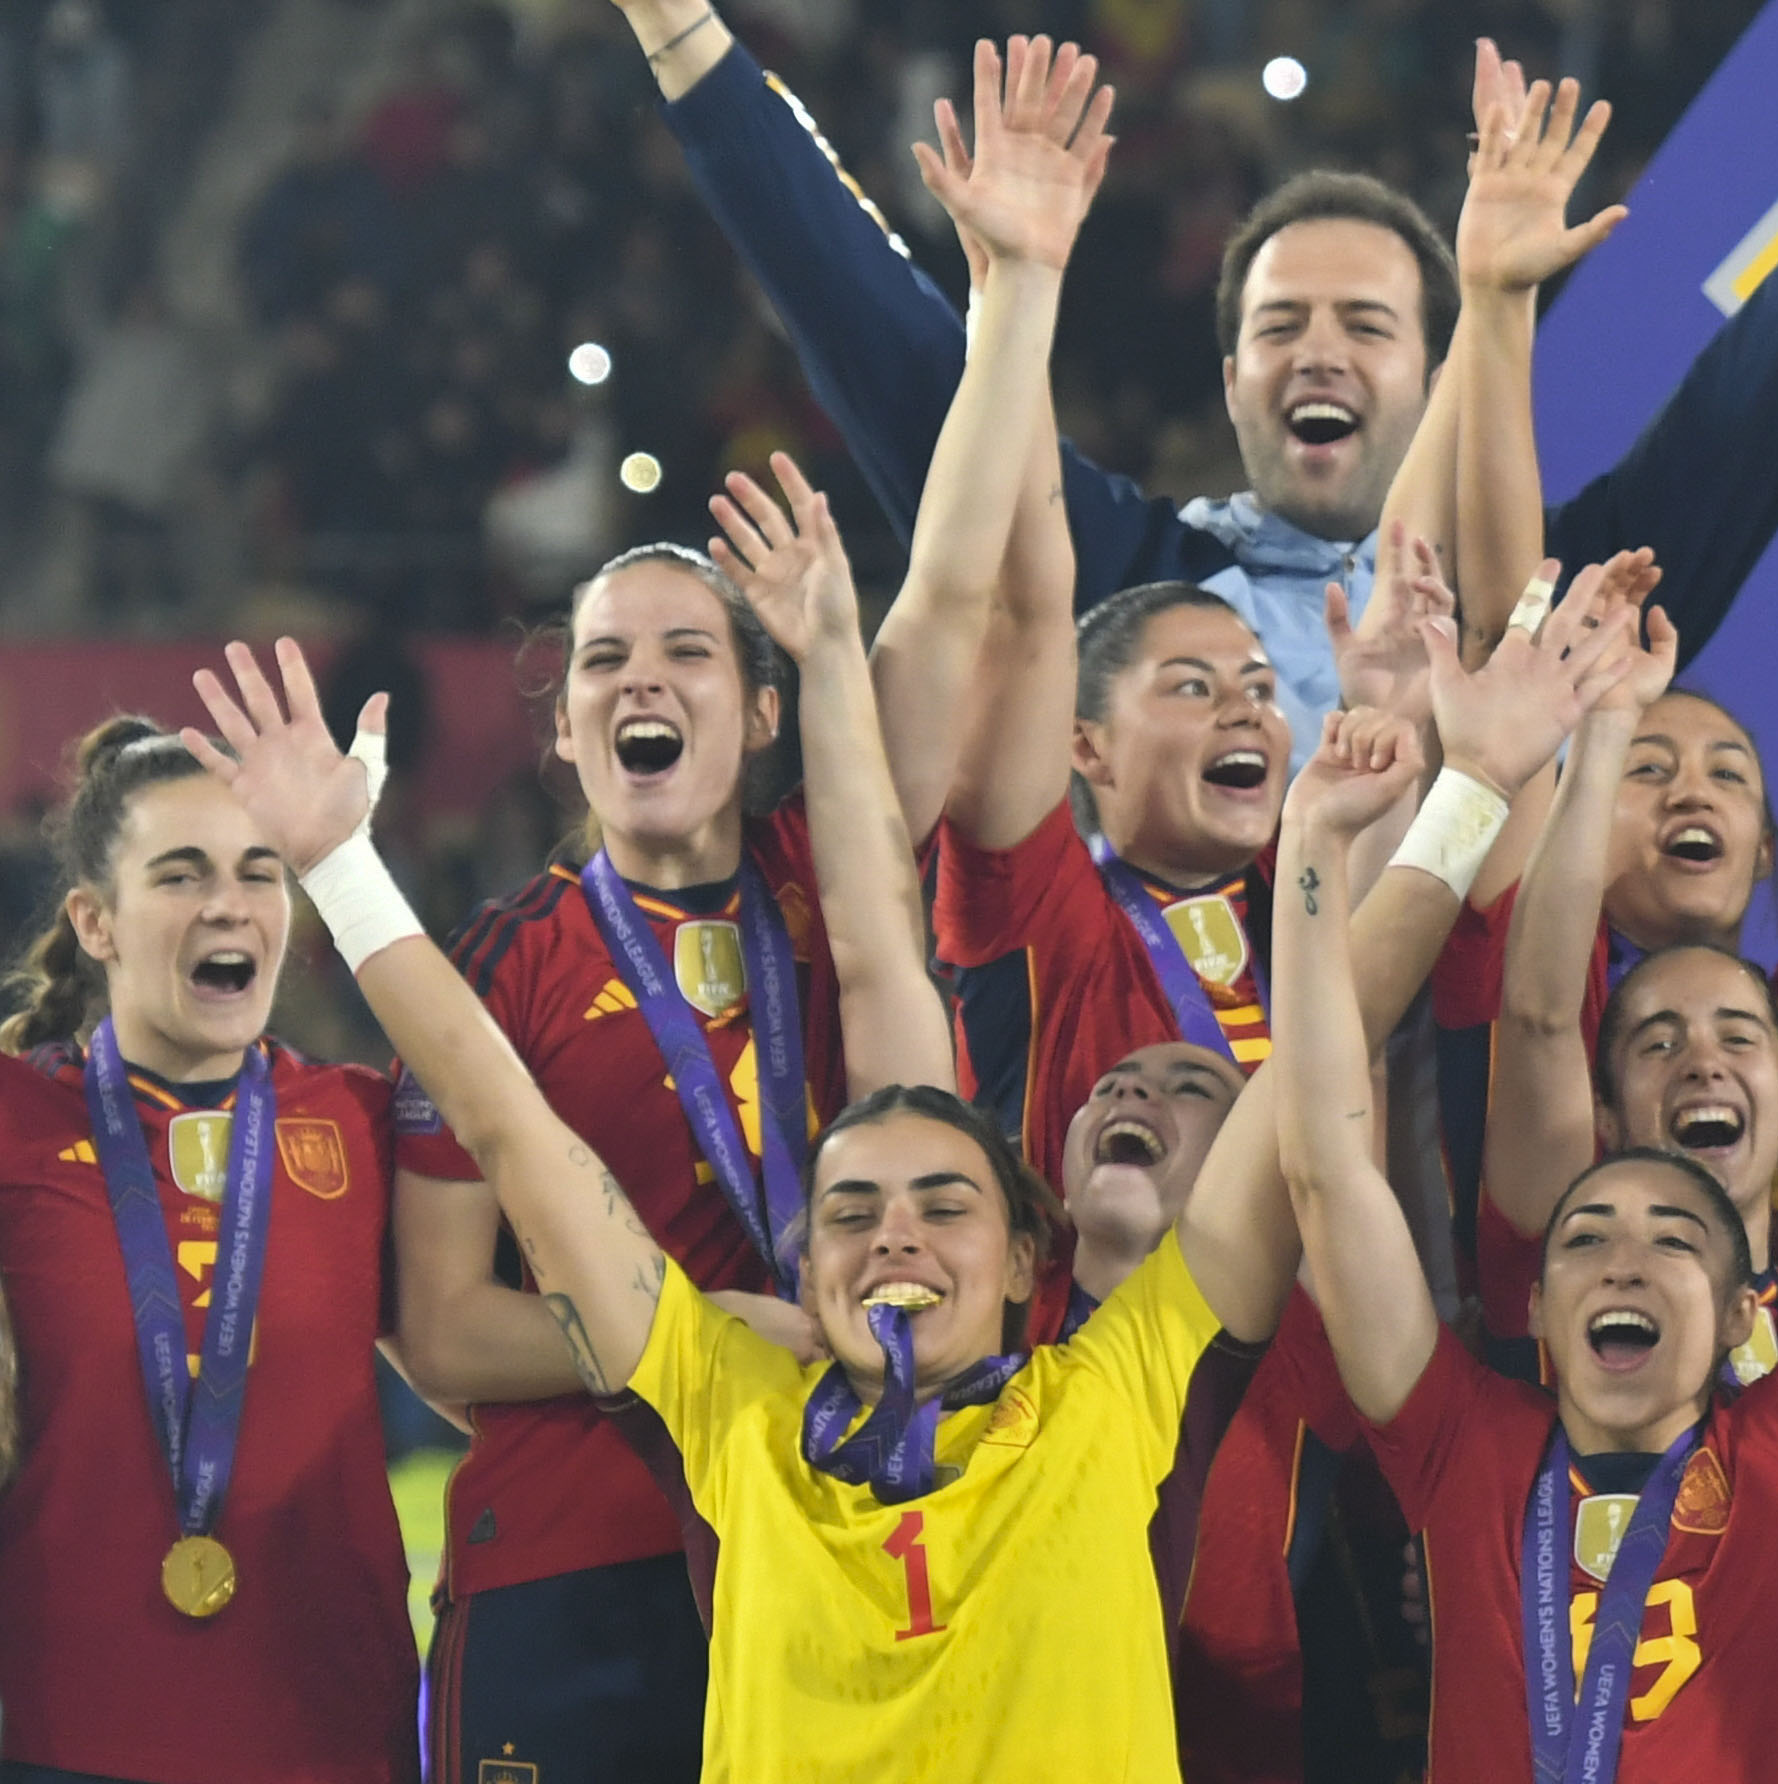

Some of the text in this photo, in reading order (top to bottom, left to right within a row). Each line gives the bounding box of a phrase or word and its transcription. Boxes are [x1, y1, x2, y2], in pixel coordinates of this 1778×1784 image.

[623, 935, 664, 997] LEAGUE
[770, 1033, 787, 1079] UEFA
[244, 1093, 265, 1157] LEAGUE
[692, 1084, 719, 1130] UEFA
[236, 1156, 260, 1231] NATIONS
[153, 1331, 173, 1378] UEFA
[216, 1306, 240, 1357] UEFA
[886, 1439, 907, 1486] UEFA
[185, 1458, 216, 1529] LEAGUE
[882, 1511, 947, 1641] 1
[1537, 1528, 1554, 1602] NATIONS
[1543, 1679, 1563, 1737] UEFA
[1594, 1664, 1616, 1708] UEFA
